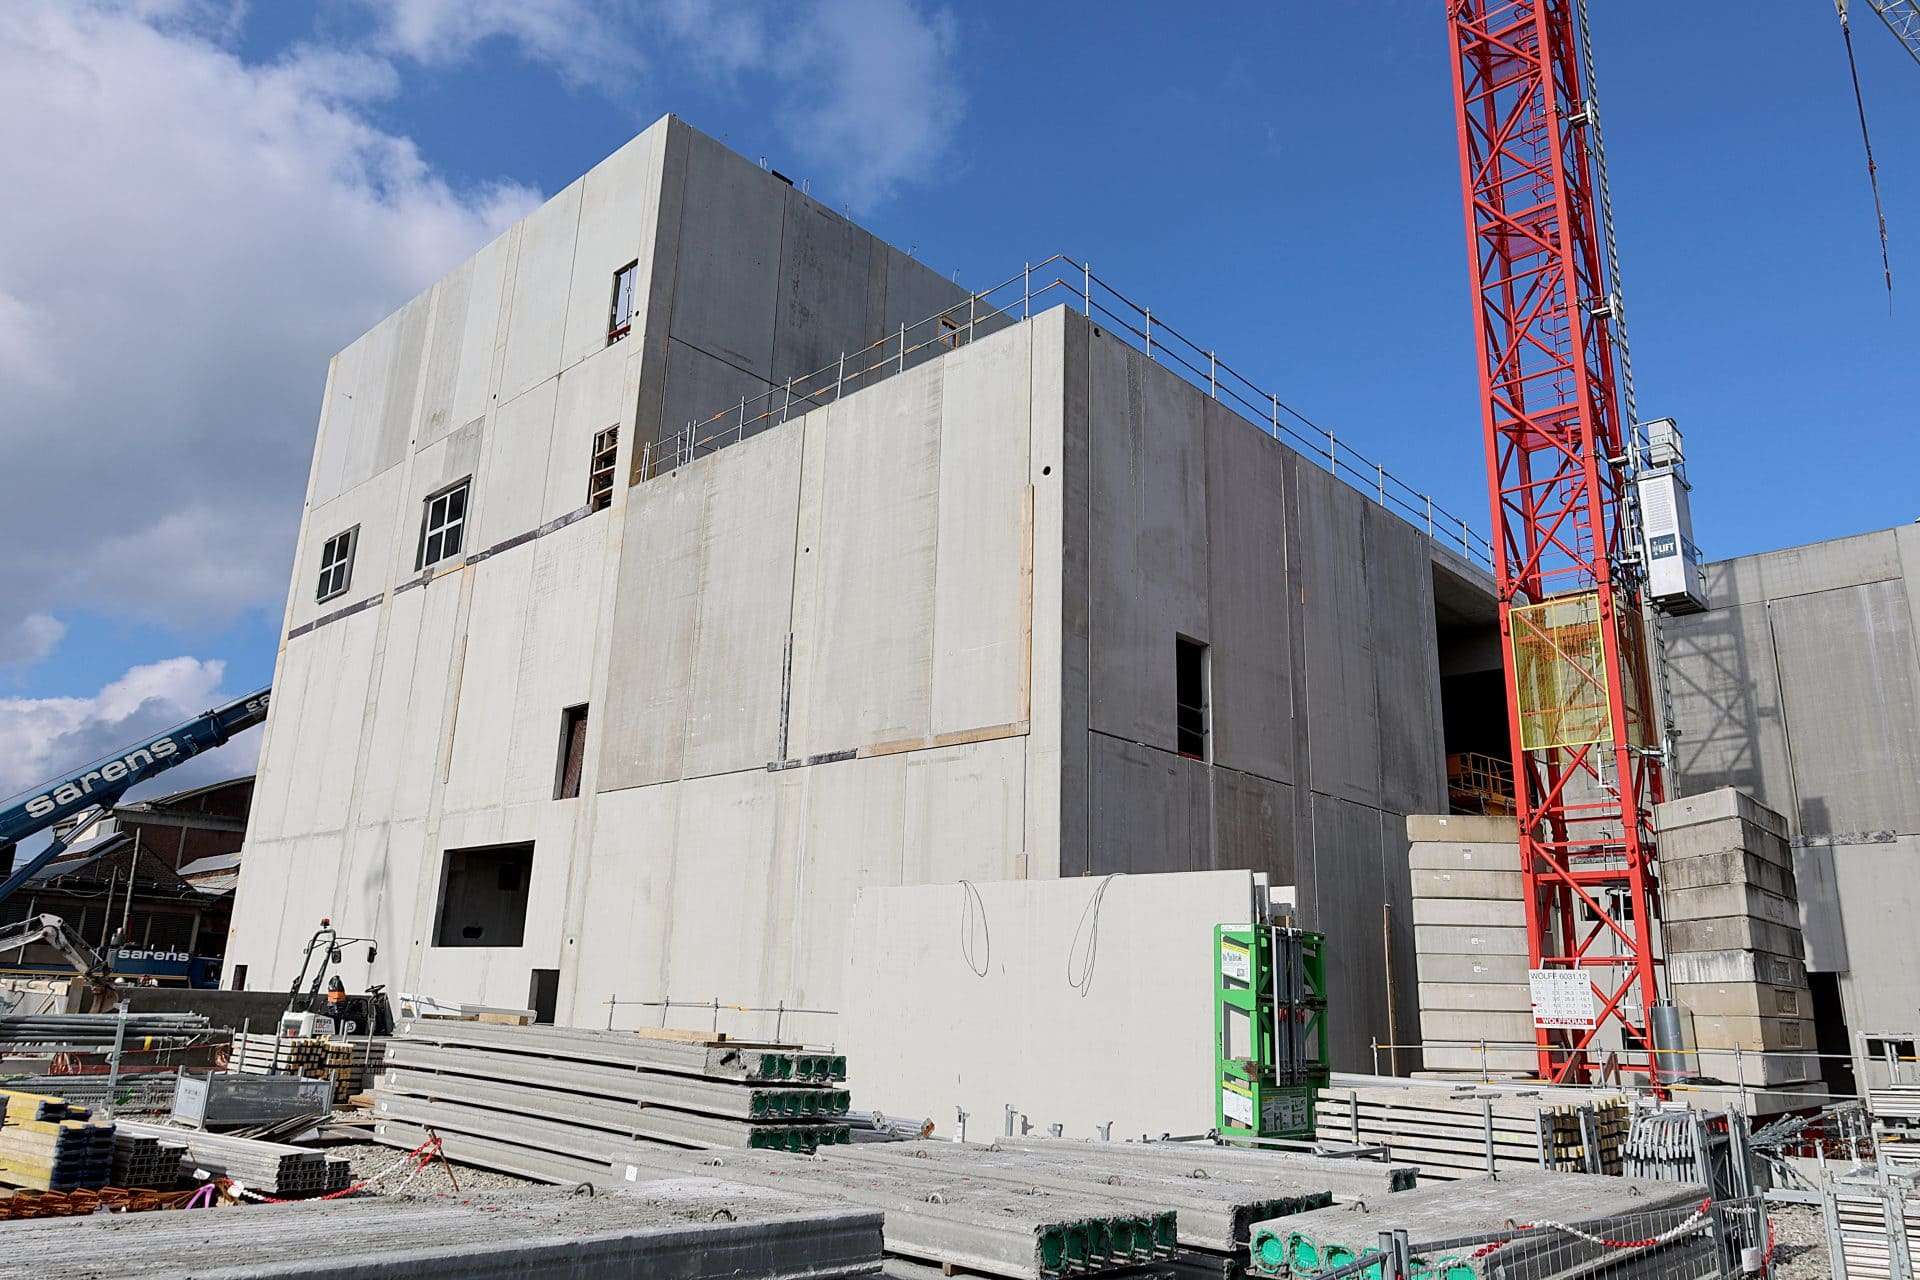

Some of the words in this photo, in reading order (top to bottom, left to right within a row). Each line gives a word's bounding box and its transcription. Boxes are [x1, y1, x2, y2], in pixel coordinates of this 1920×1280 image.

[25, 737, 178, 818] sarens
[118, 949, 189, 962] sarens
[1543, 1017, 1587, 1026] WOLFFKRAN
